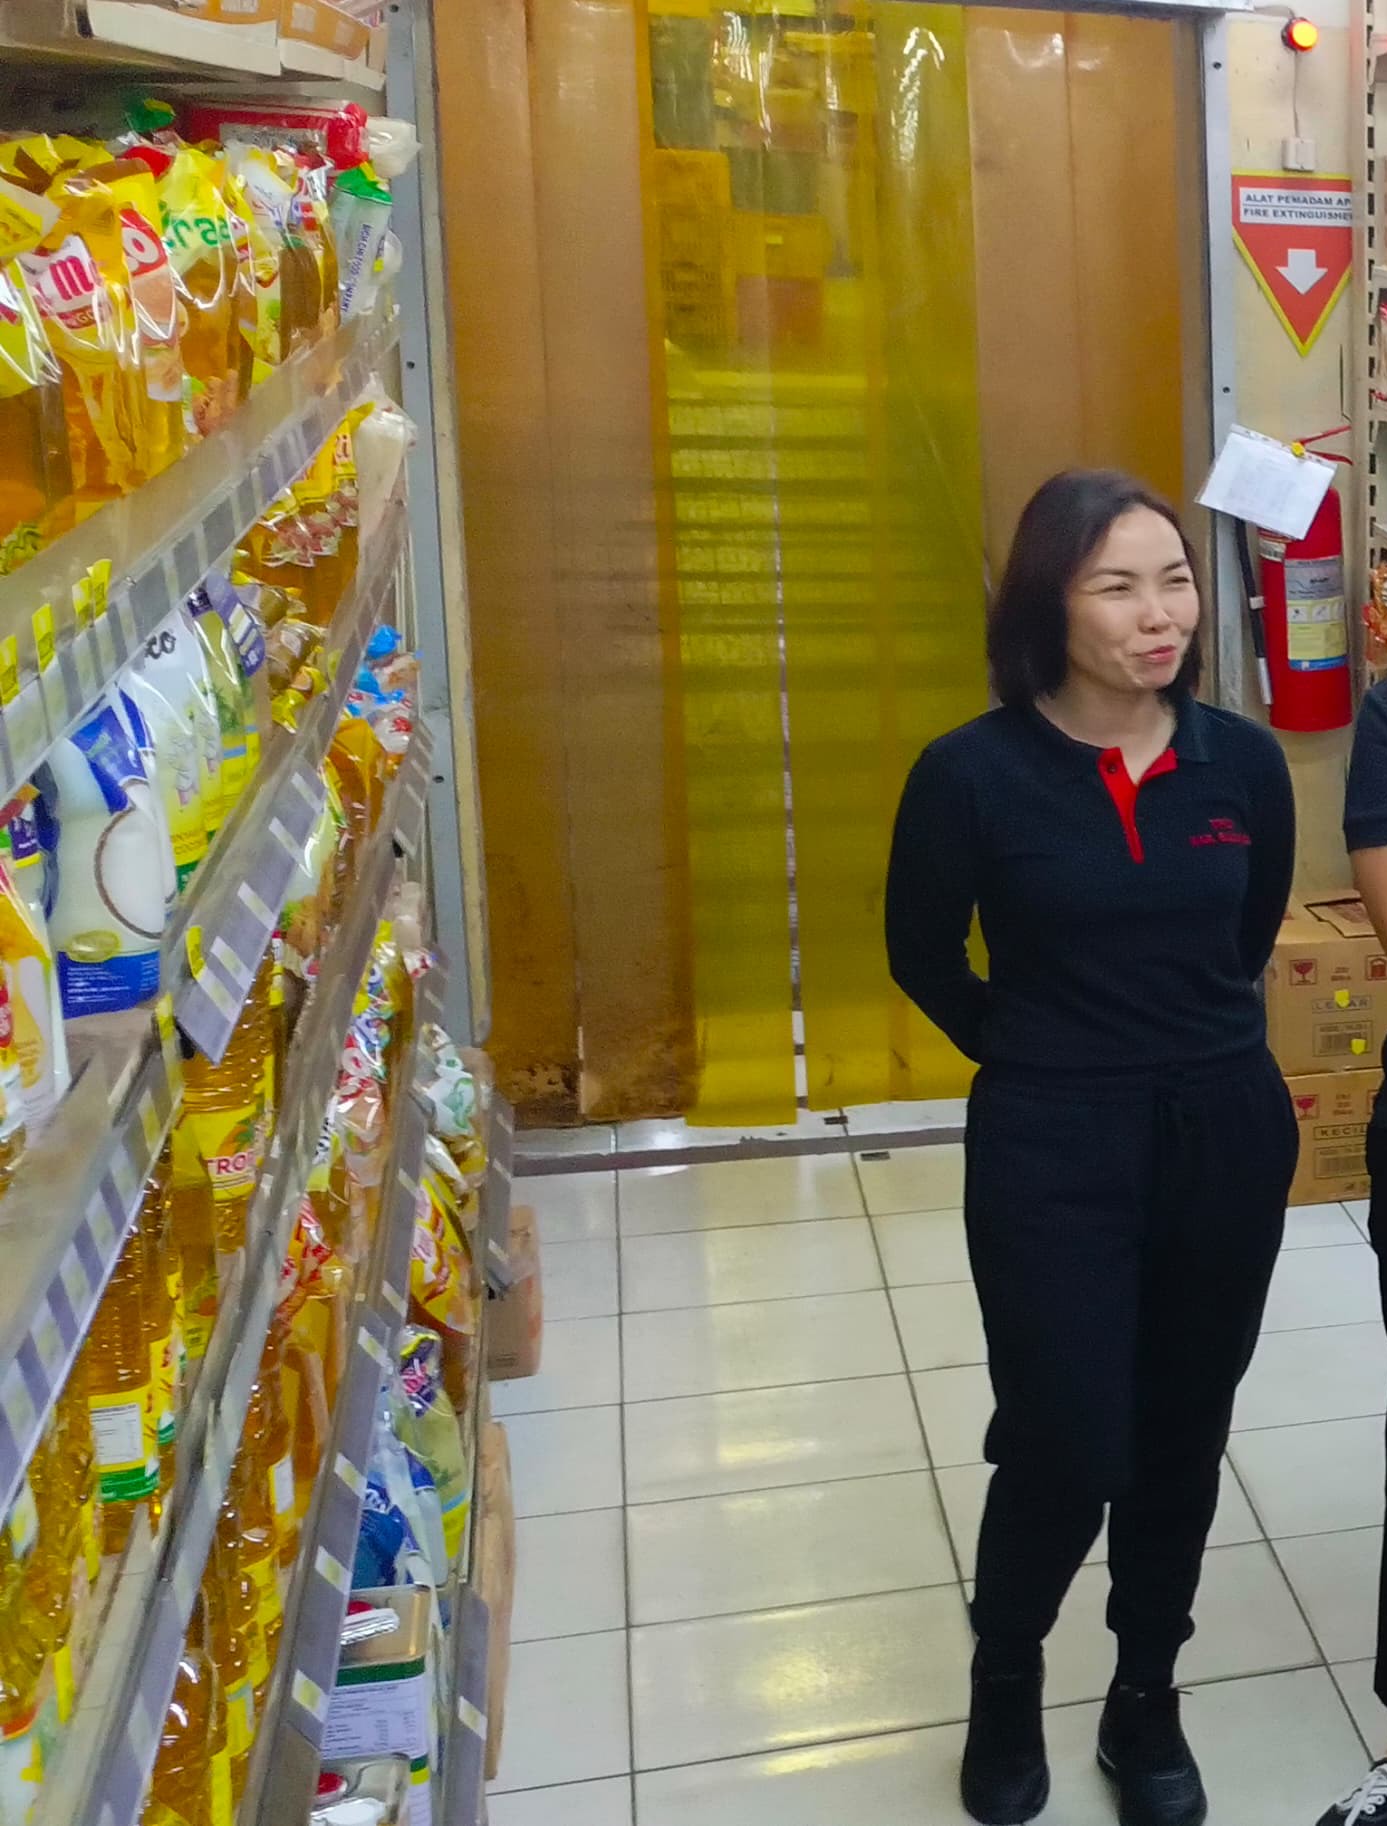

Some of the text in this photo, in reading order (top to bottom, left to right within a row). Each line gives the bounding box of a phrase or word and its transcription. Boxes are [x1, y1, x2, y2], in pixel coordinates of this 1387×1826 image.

[1245, 194, 1352, 207] ALAT PEMADAM AP
[1244, 208, 1269, 218] FIRE
[1315, 1000, 1368, 1010] LEAR
